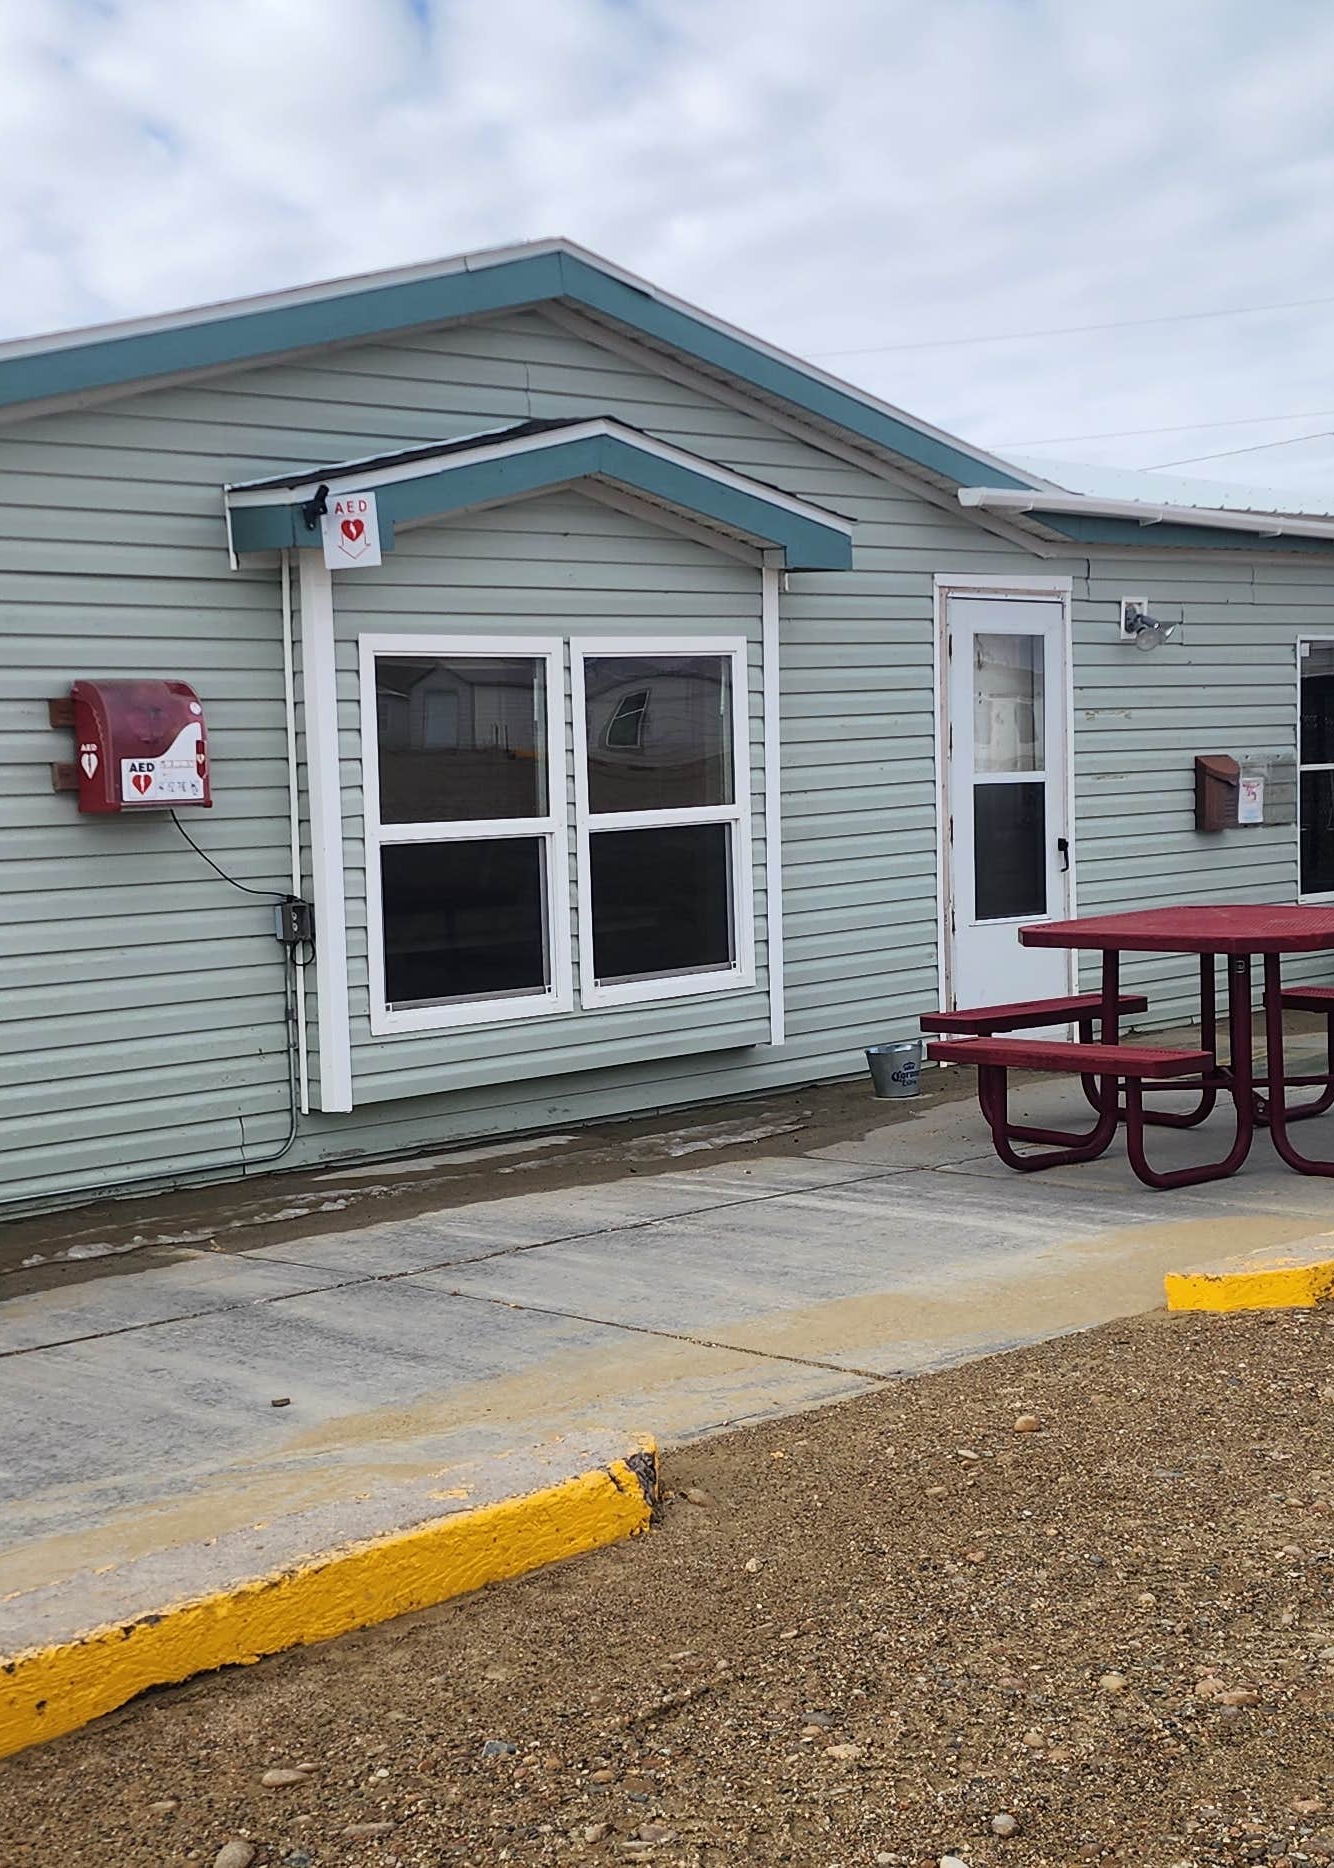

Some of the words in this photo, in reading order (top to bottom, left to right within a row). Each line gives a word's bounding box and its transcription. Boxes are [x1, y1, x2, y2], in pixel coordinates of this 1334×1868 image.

[334, 500, 368, 515] AED
[80, 743, 98, 752] AED
[129, 762, 155, 773] AED
